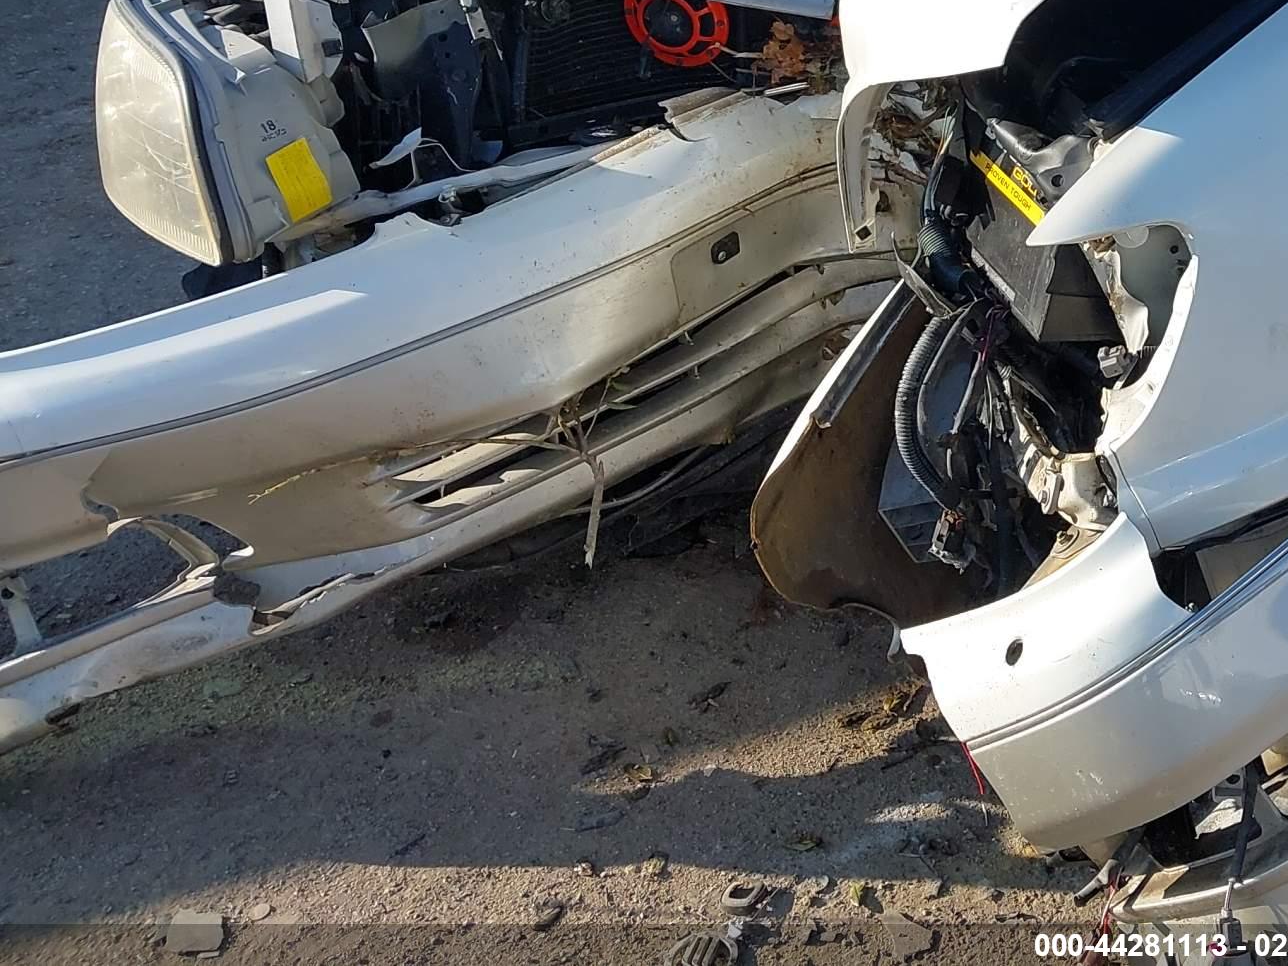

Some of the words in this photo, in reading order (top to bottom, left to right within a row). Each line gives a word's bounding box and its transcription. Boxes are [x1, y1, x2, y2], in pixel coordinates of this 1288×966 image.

[260, 119, 276, 134] 18
[985, 163, 1010, 188] PROVEN
[1011, 187, 1032, 211] TOUGH
